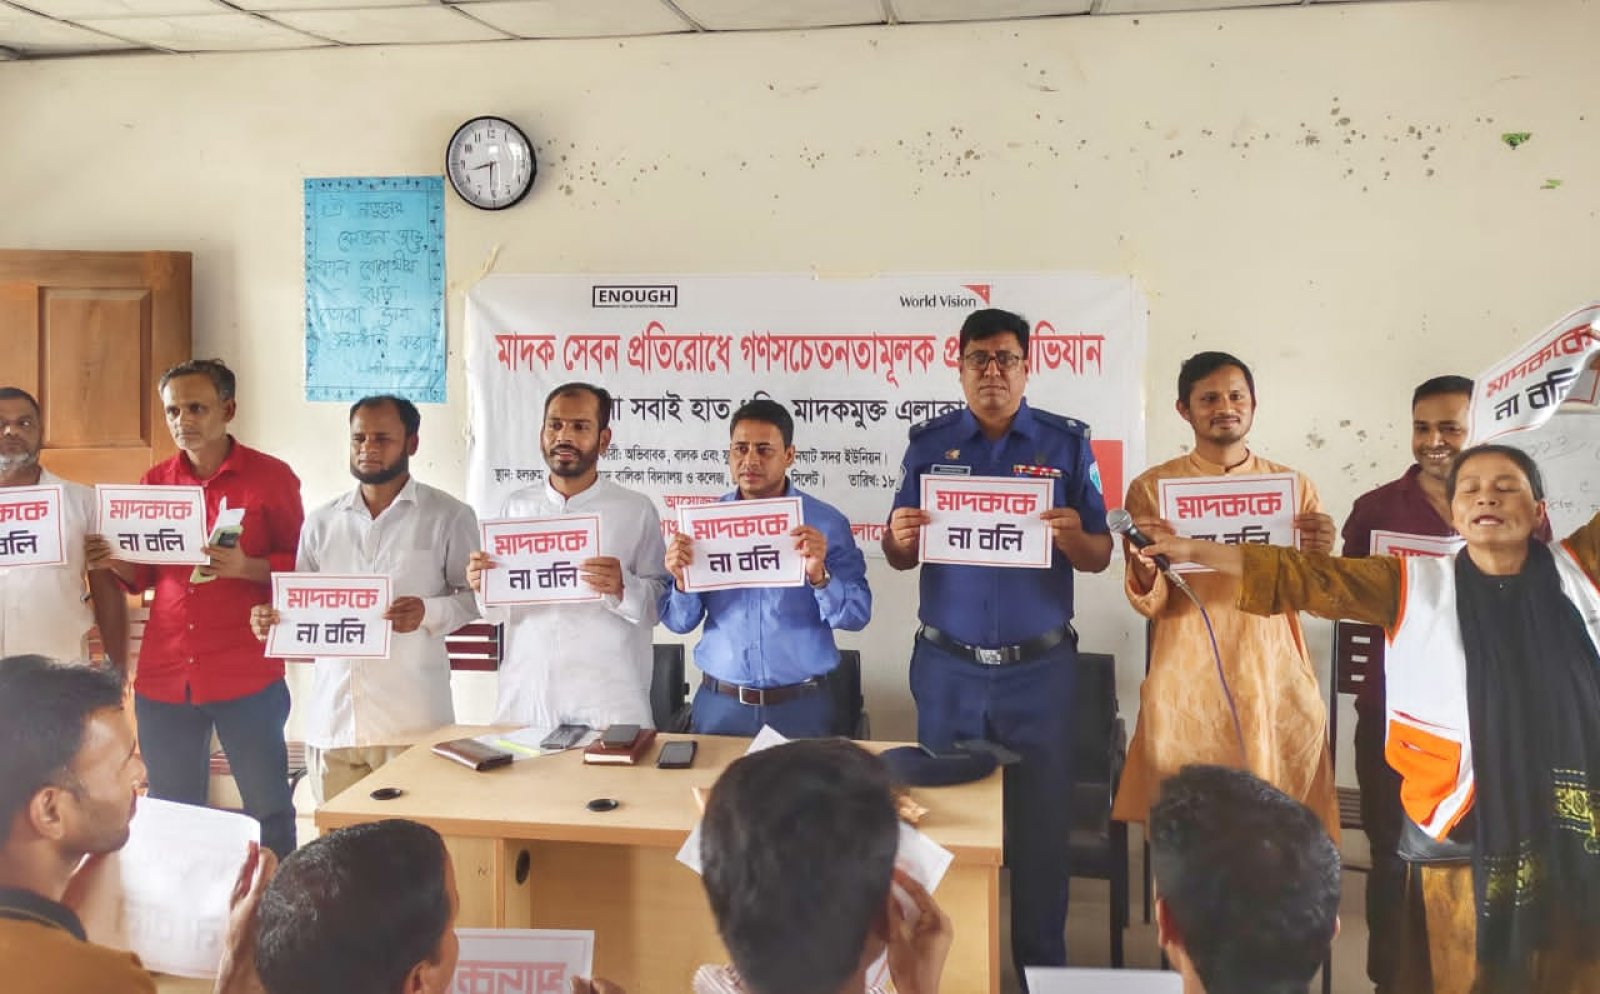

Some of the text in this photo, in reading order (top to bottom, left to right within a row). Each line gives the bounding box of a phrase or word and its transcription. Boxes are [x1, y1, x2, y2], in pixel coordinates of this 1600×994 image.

[487, 129, 495, 139] 12
[599, 289, 671, 303] ENOUGH
[900, 295, 976, 308] World Vision
[495, 332, 556, 373] মাদক
[563, 334, 621, 373] সেবন
[627, 320, 732, 375] প্রতিরোধে
[740, 330, 937, 388] গণসচেতনতামূলক
[1029, 320, 1105, 375] ভিযান
[1486, 323, 1592, 398] মাদককে
[630, 390, 683, 422] সবাই
[690, 397, 732, 421] হাত
[791, 397, 888, 430] মাদকমুক্ত
[1494, 394, 1520, 421] না
[109, 500, 193, 521] মাদককে
[935, 490, 1038, 515] মাদককে
[1175, 492, 1283, 519] মাদককে
[118, 528, 185, 552] না বলি
[692, 513, 789, 541] মাদককে
[948, 524, 1024, 552] না বলি
[494, 529, 588, 556] মাদককে
[708, 545, 780, 574] না বলি
[509, 561, 579, 590] না বলি
[286, 588, 379, 610] মাদককে
[297, 617, 365, 645] না বলি
